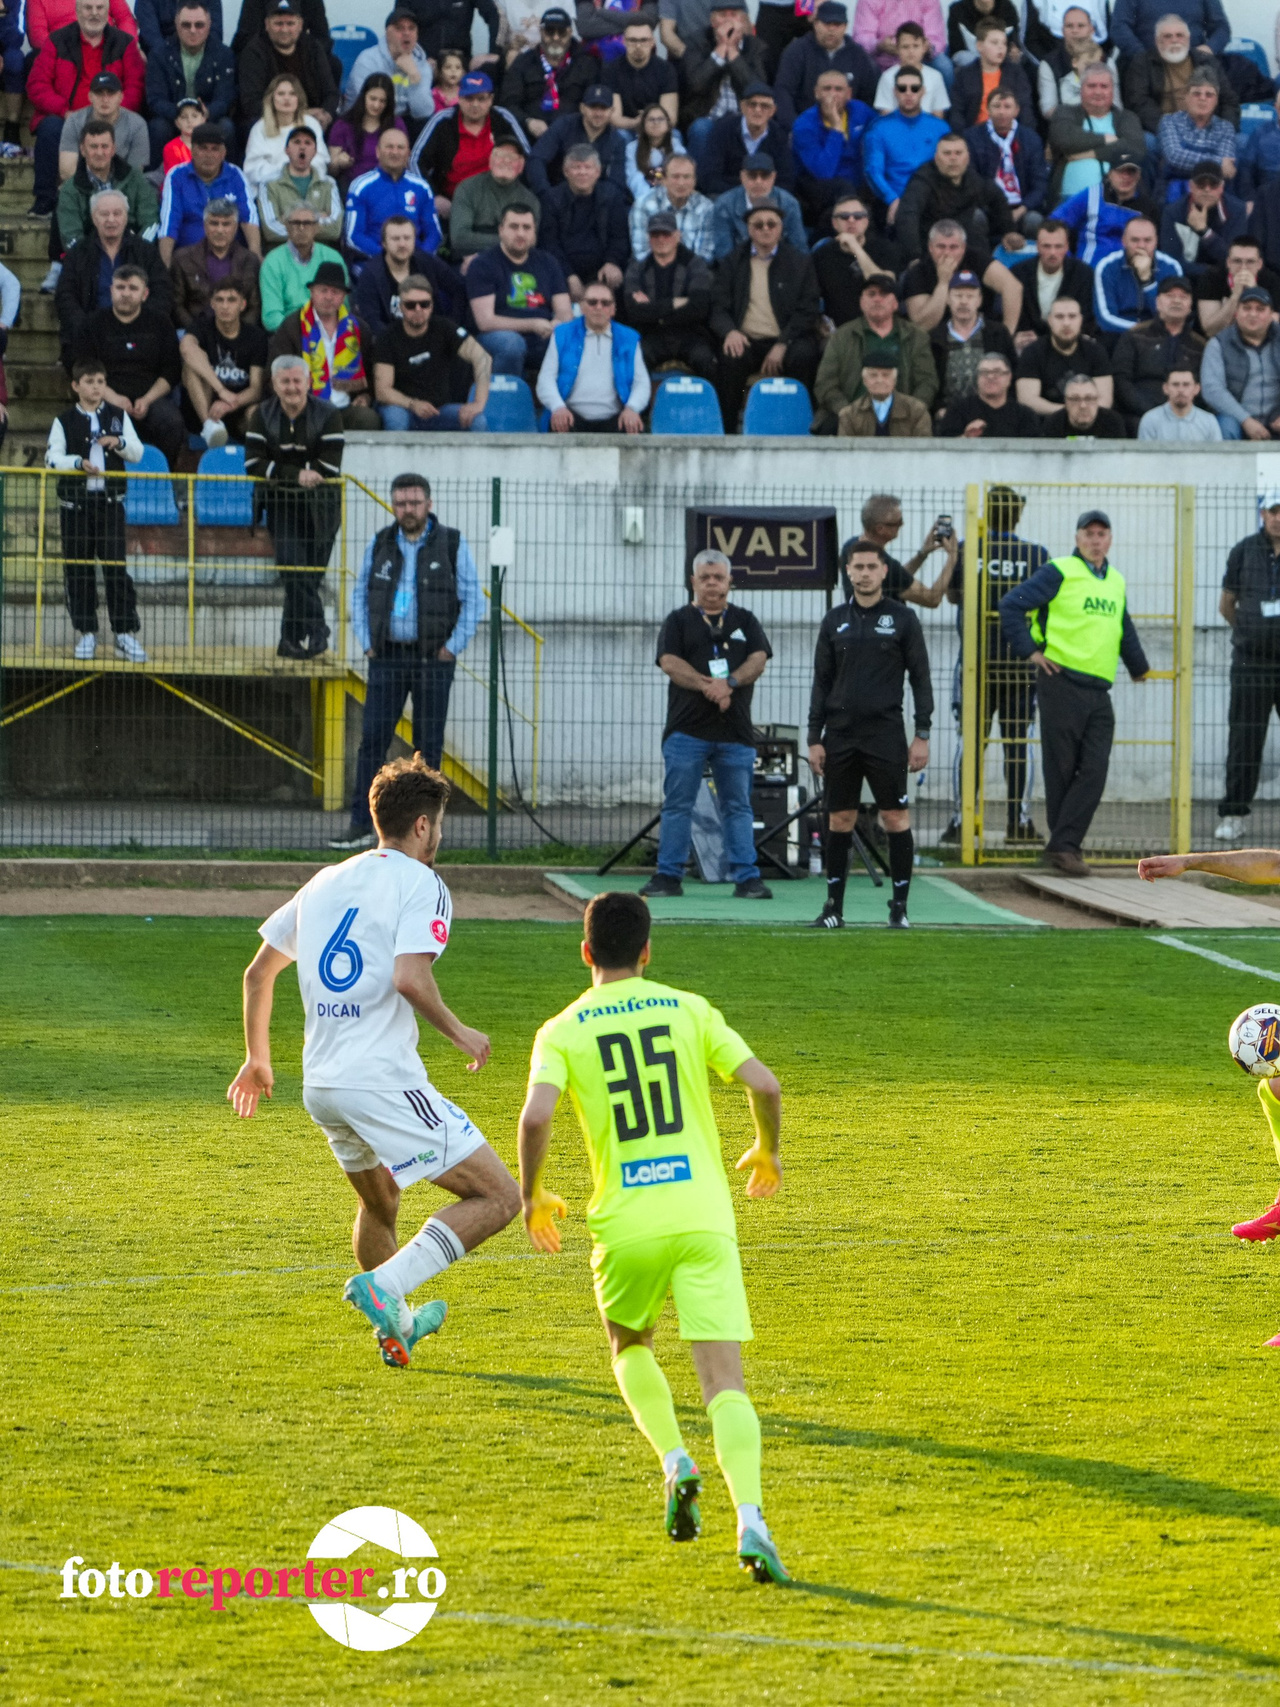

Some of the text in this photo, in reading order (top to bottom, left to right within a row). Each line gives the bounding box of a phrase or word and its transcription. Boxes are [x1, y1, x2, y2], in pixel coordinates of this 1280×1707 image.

[712, 526, 808, 557] VAR
[976, 558, 1027, 577] FCBT
[318, 907, 364, 993] 6
[317, 1003, 361, 1018] DICAN
[576, 996, 679, 1024] Panifcom
[596, 1024, 684, 1142] 35
[391, 1149, 435, 1173] Smart Eco
[423, 1155, 438, 1166] Plus
